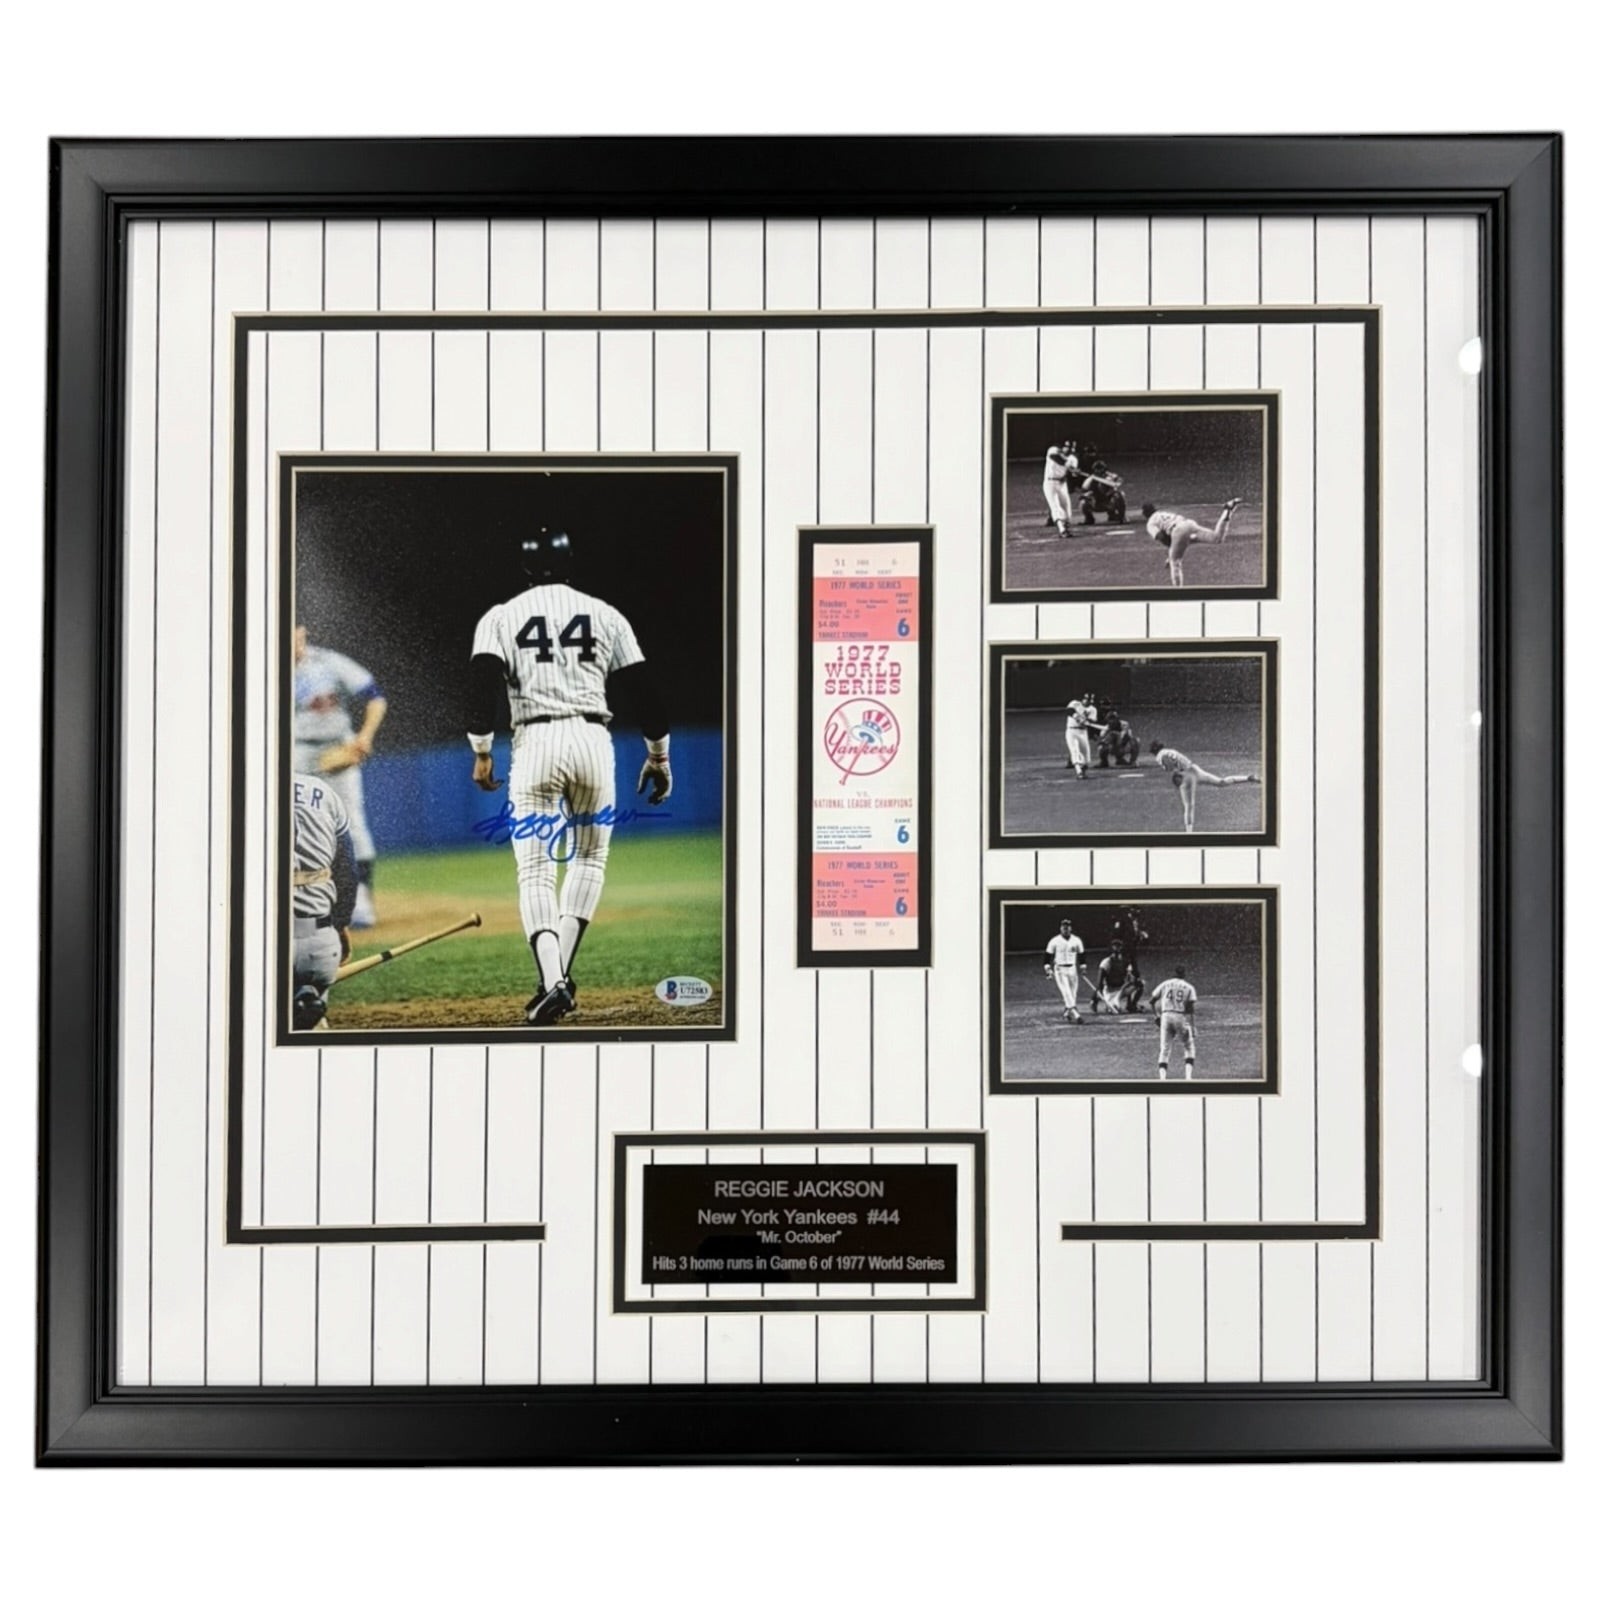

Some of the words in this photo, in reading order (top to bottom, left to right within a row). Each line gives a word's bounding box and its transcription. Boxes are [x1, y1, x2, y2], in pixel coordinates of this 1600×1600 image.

[831, 581, 846, 590] 1977
[849, 581, 874, 590] WORLD
[878, 580, 902, 589] SERIES
[897, 617, 910, 637] 6
[515, 615, 598, 663] 44
[836, 645, 890, 661] 1977
[824, 662, 902, 678] WORLD
[824, 679, 902, 695] SERIES
[826, 722, 896, 758] Yankees
[813, 799, 844, 809] NATIONAL
[847, 799, 872, 809] LEAGUE
[874, 798, 913, 808] CHAMPIONS
[897, 825, 910, 844] 6
[828, 861, 843, 870] 1977
[847, 861, 871, 869] WORLD
[874, 861, 898, 869] SERIES
[896, 896, 908, 916] 6
[1167, 990, 1184, 1003] 49
[714, 1181, 789, 1198] REGGIE
[793, 1181, 884, 1198] JACKSON
[698, 1209, 736, 1225] New
[741, 1209, 779, 1225] York
[783, 1209, 858, 1225] Yankees
[867, 1209, 900, 1225] #44
[653, 1256, 676, 1271] Hits
[679, 1256, 687, 1271] 3
[690, 1256, 725, 1271] home
[727, 1259, 754, 1271] runs
[756, 1256, 767, 1271] in
[770, 1256, 807, 1271] Game
[809, 1256, 818, 1271] 6
[820, 1256, 833, 1271] of
[836, 1256, 865, 1271] 1977
[868, 1256, 904, 1271] World
[906, 1256, 945, 1271] Series
